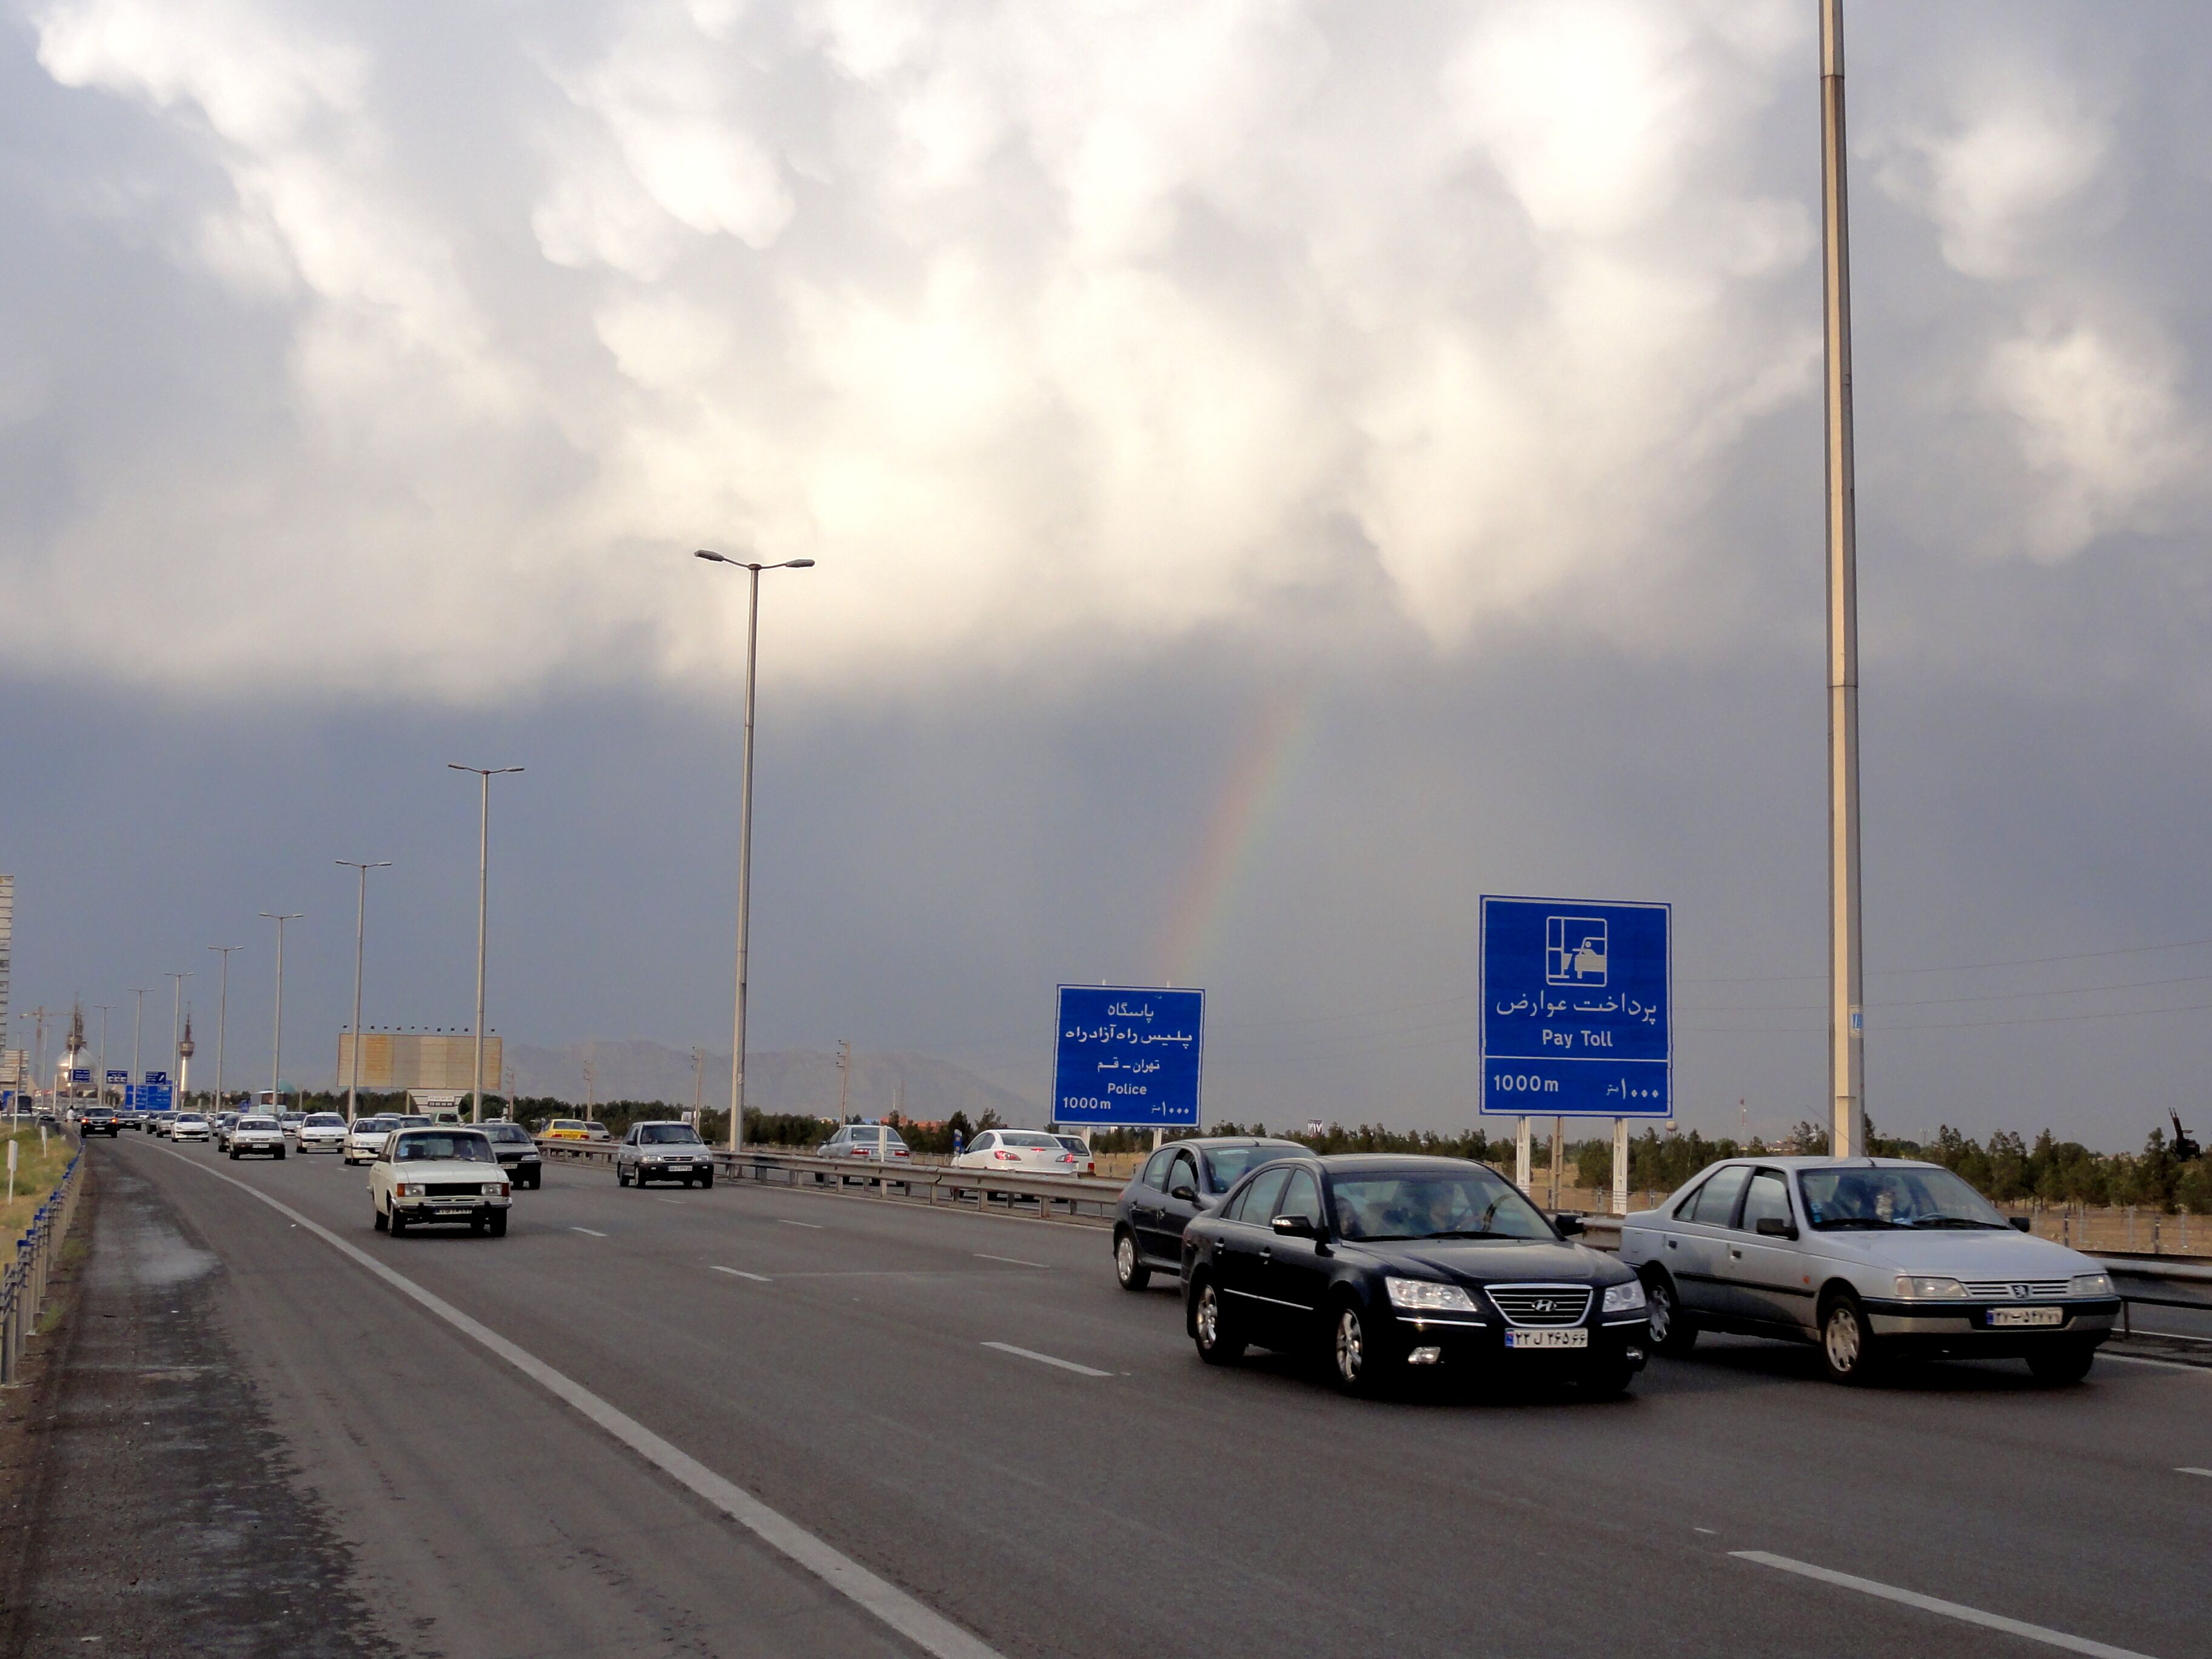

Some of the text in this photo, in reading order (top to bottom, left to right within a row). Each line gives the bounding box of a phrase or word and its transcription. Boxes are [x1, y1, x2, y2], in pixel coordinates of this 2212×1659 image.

[1107, 1002, 1154, 1023] پاسگاه
[1496, 989, 1657, 1025] پرداخت عوارض
[1140, 1030, 1193, 1049] پلیس
[1542, 1029, 1613, 1048] Pay Toll
[1097, 1056, 1119, 1073] قم
[1133, 1059, 1160, 1073] تهران
[1107, 1082, 1147, 1095] Police
